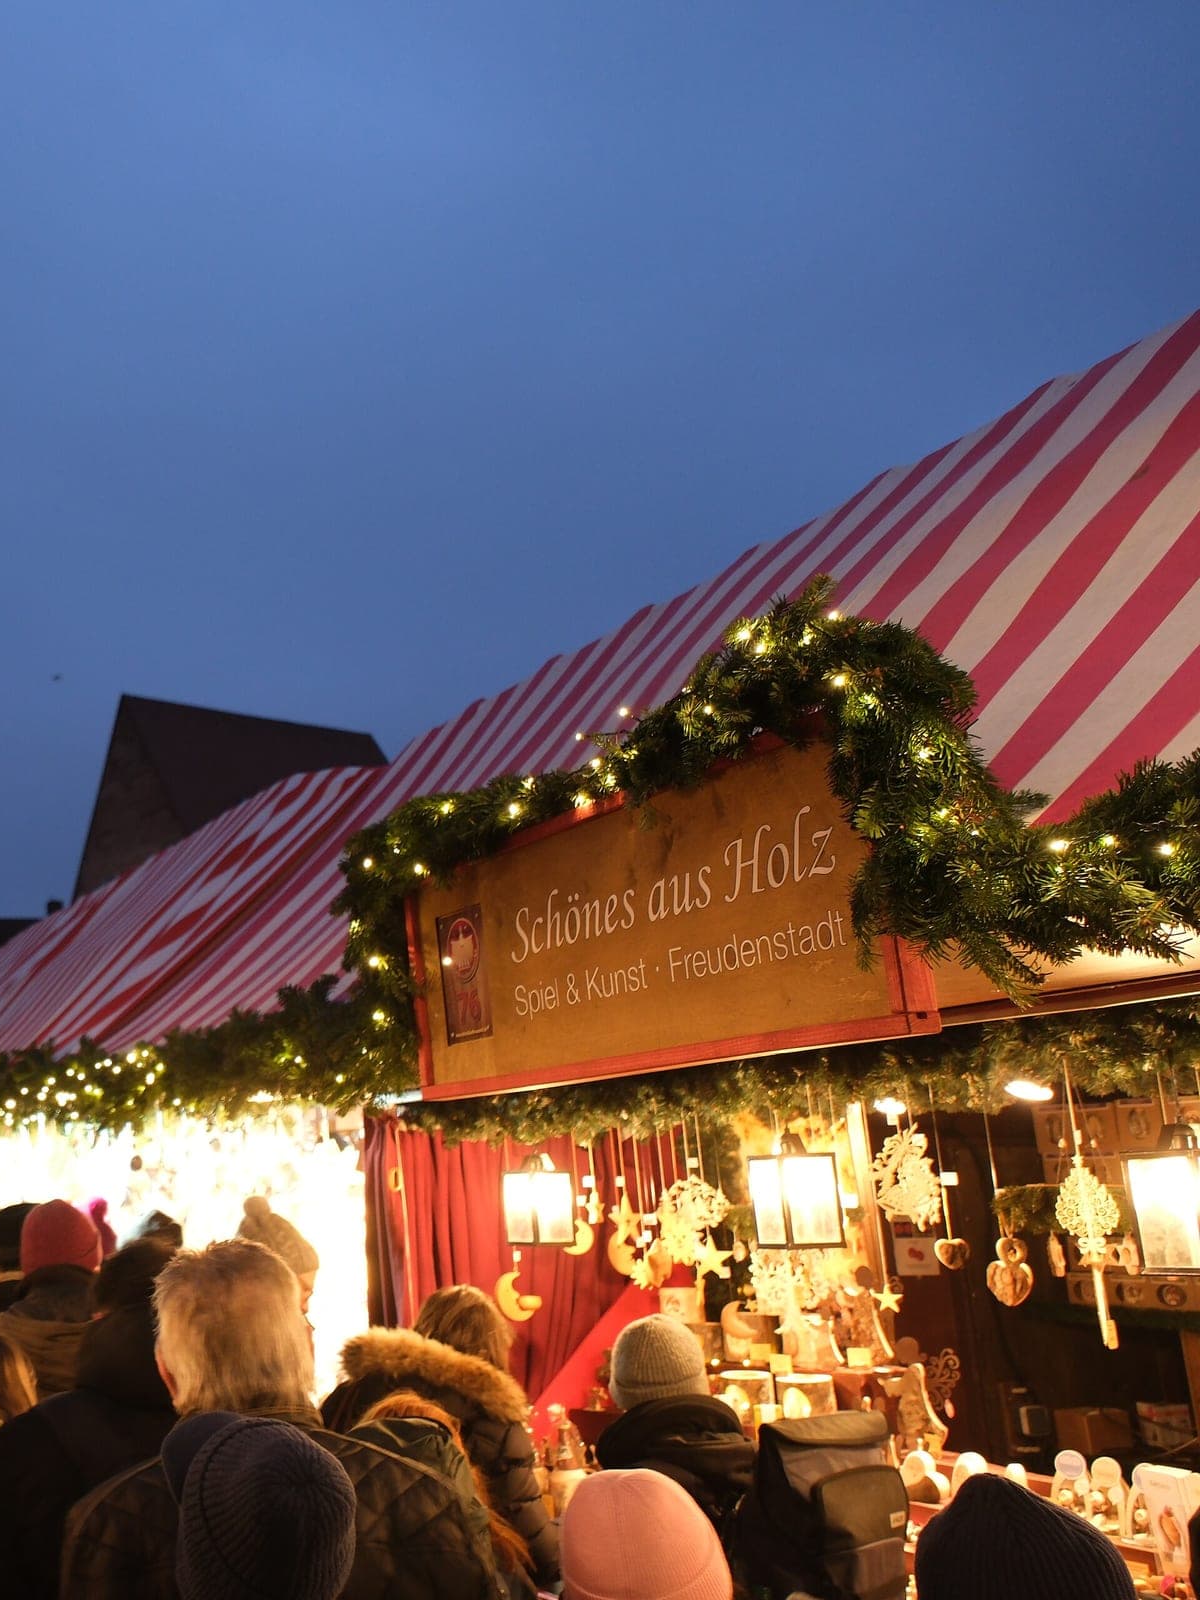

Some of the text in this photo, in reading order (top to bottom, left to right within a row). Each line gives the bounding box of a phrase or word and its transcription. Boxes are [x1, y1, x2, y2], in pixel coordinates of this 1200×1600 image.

[511, 805, 836, 963] Schönes aus Holz
[514, 910, 847, 1020] Spiel & Kunst Freudenstadt
